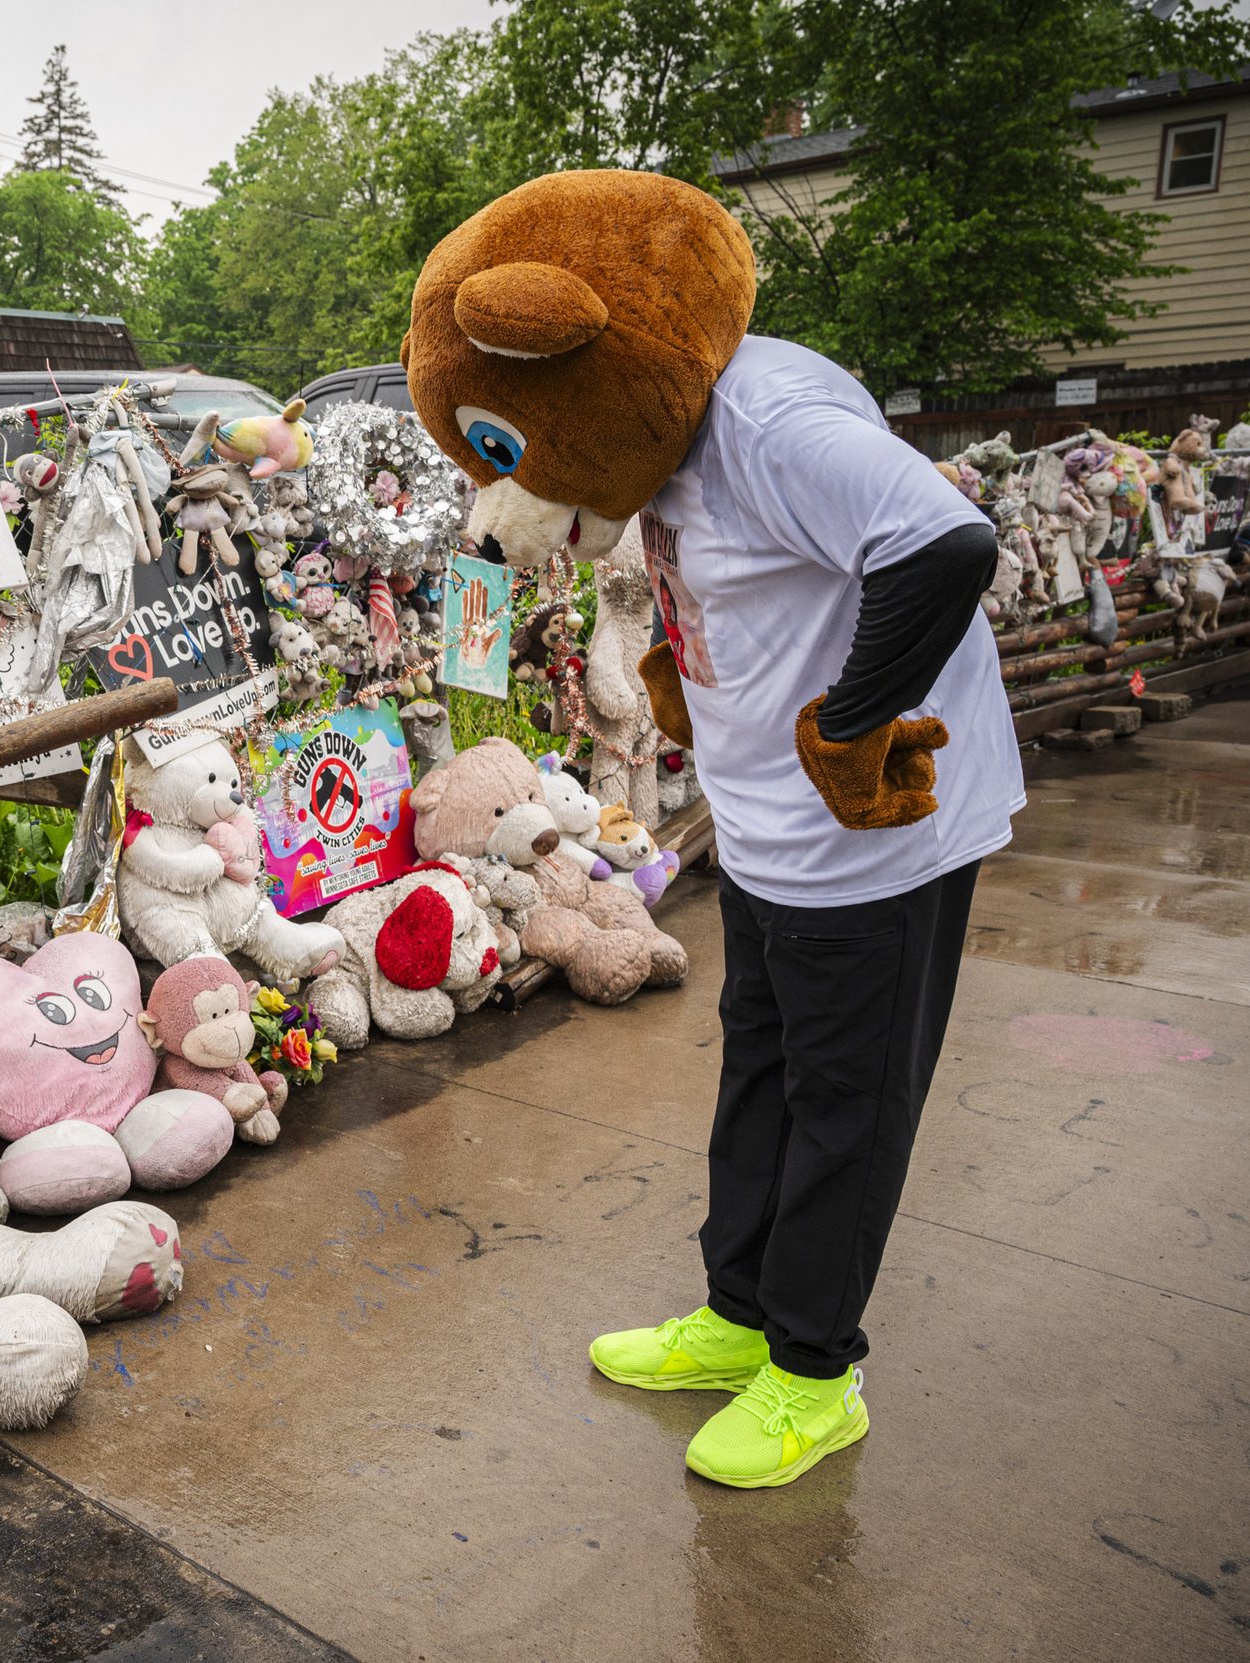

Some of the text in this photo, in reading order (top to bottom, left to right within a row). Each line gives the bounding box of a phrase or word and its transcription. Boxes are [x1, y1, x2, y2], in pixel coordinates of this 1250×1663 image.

[168, 571, 251, 621] Down.
[152, 620, 223, 668] Love
[293, 731, 368, 788] GUNS DOWN
[316, 816, 365, 848] TWIN CITIES
[349, 846, 369, 858] saves
[325, 870, 377, 895] MINNESOTA SAFE STREETS
